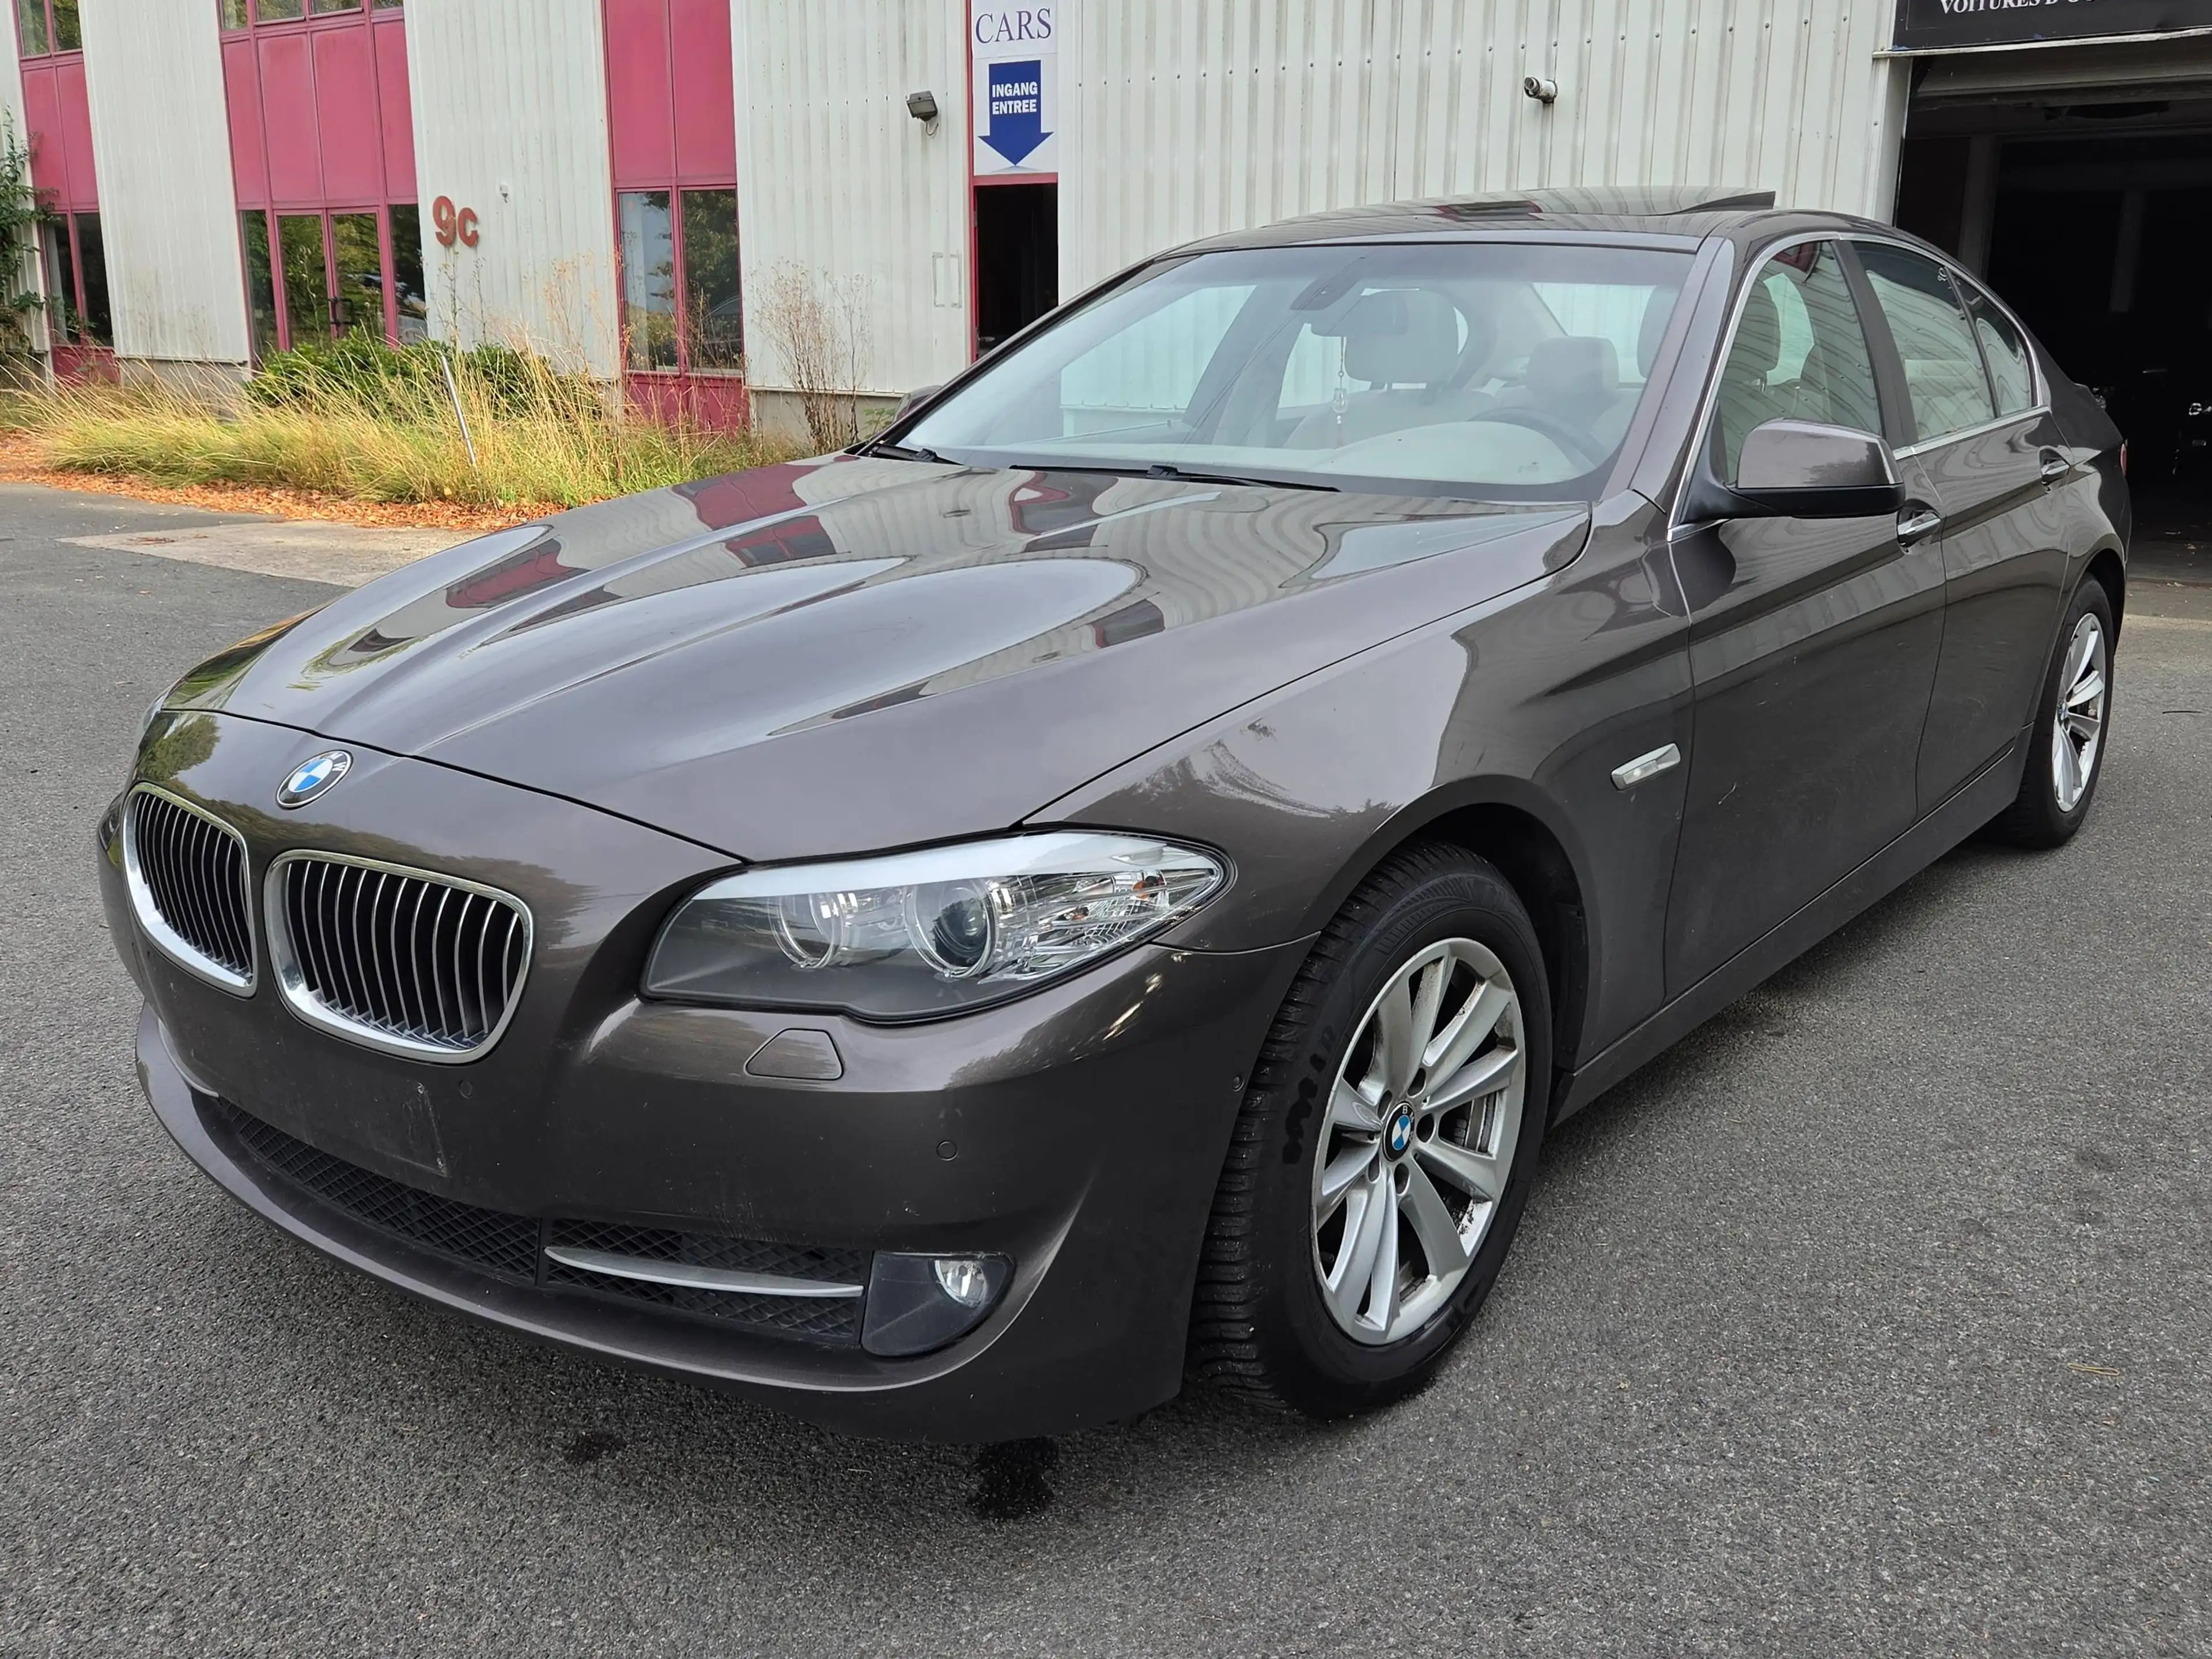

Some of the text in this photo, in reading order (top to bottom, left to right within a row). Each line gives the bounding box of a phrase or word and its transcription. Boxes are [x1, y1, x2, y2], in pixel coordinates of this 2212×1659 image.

[975, 8, 1051, 44] CARS
[992, 82, 1038, 97] INGANG
[992, 99, 1037, 115] ENTREE
